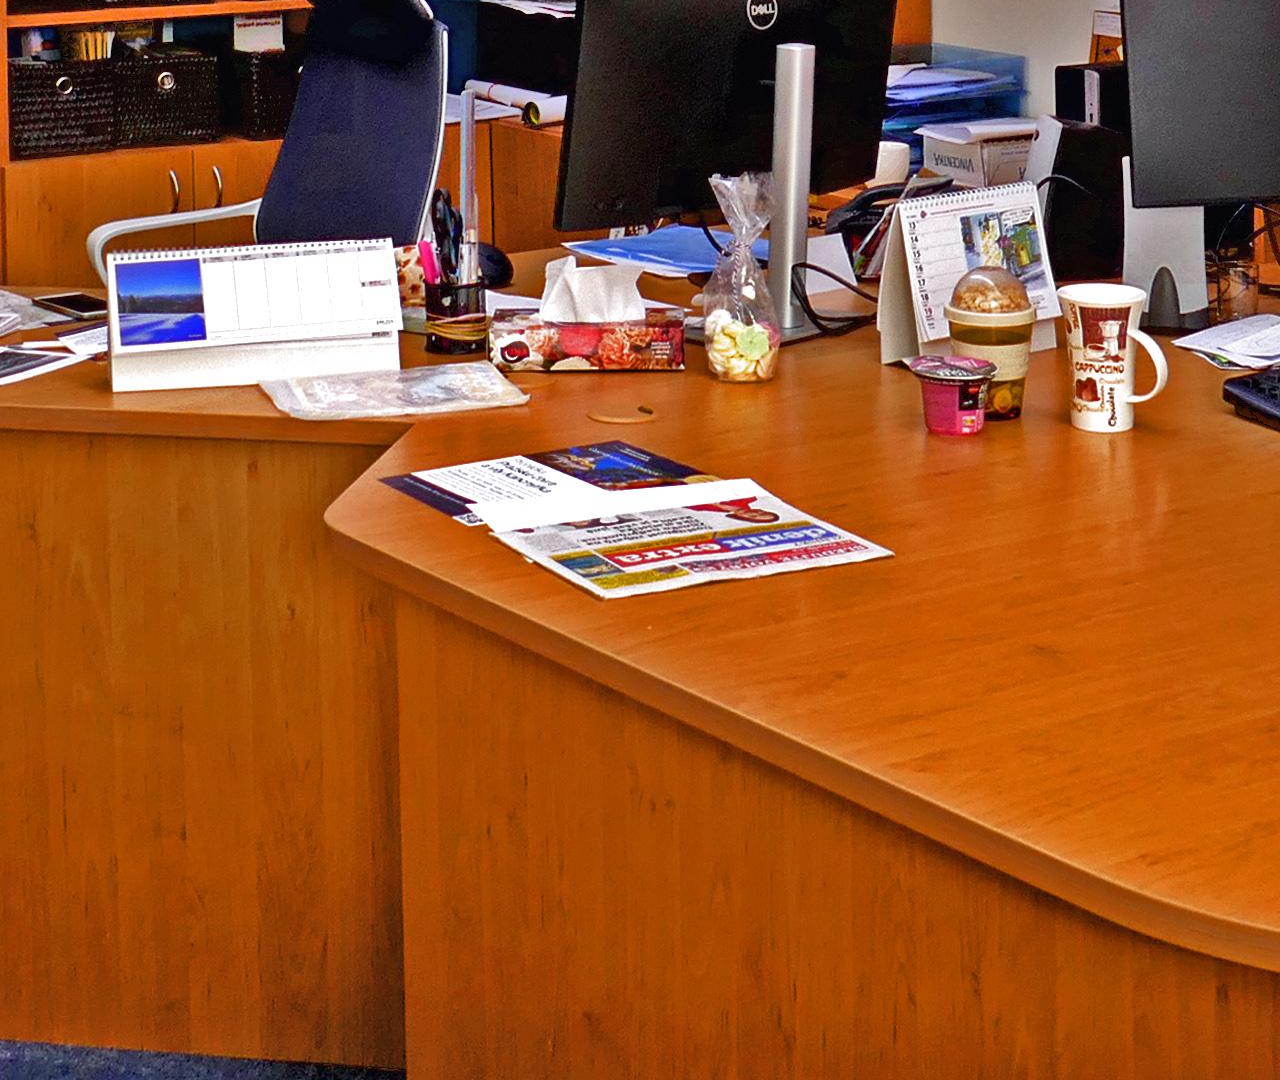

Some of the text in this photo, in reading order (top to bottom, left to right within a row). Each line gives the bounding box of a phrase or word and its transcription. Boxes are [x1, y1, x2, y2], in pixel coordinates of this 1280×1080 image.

[750, 3, 775, 16] DELL
[933, 152, 975, 172] VINCENTKA
[1075, 361, 1125, 374] CAPPUCCINO
[721, 527, 827, 550] deník
[613, 540, 722, 566] extra
